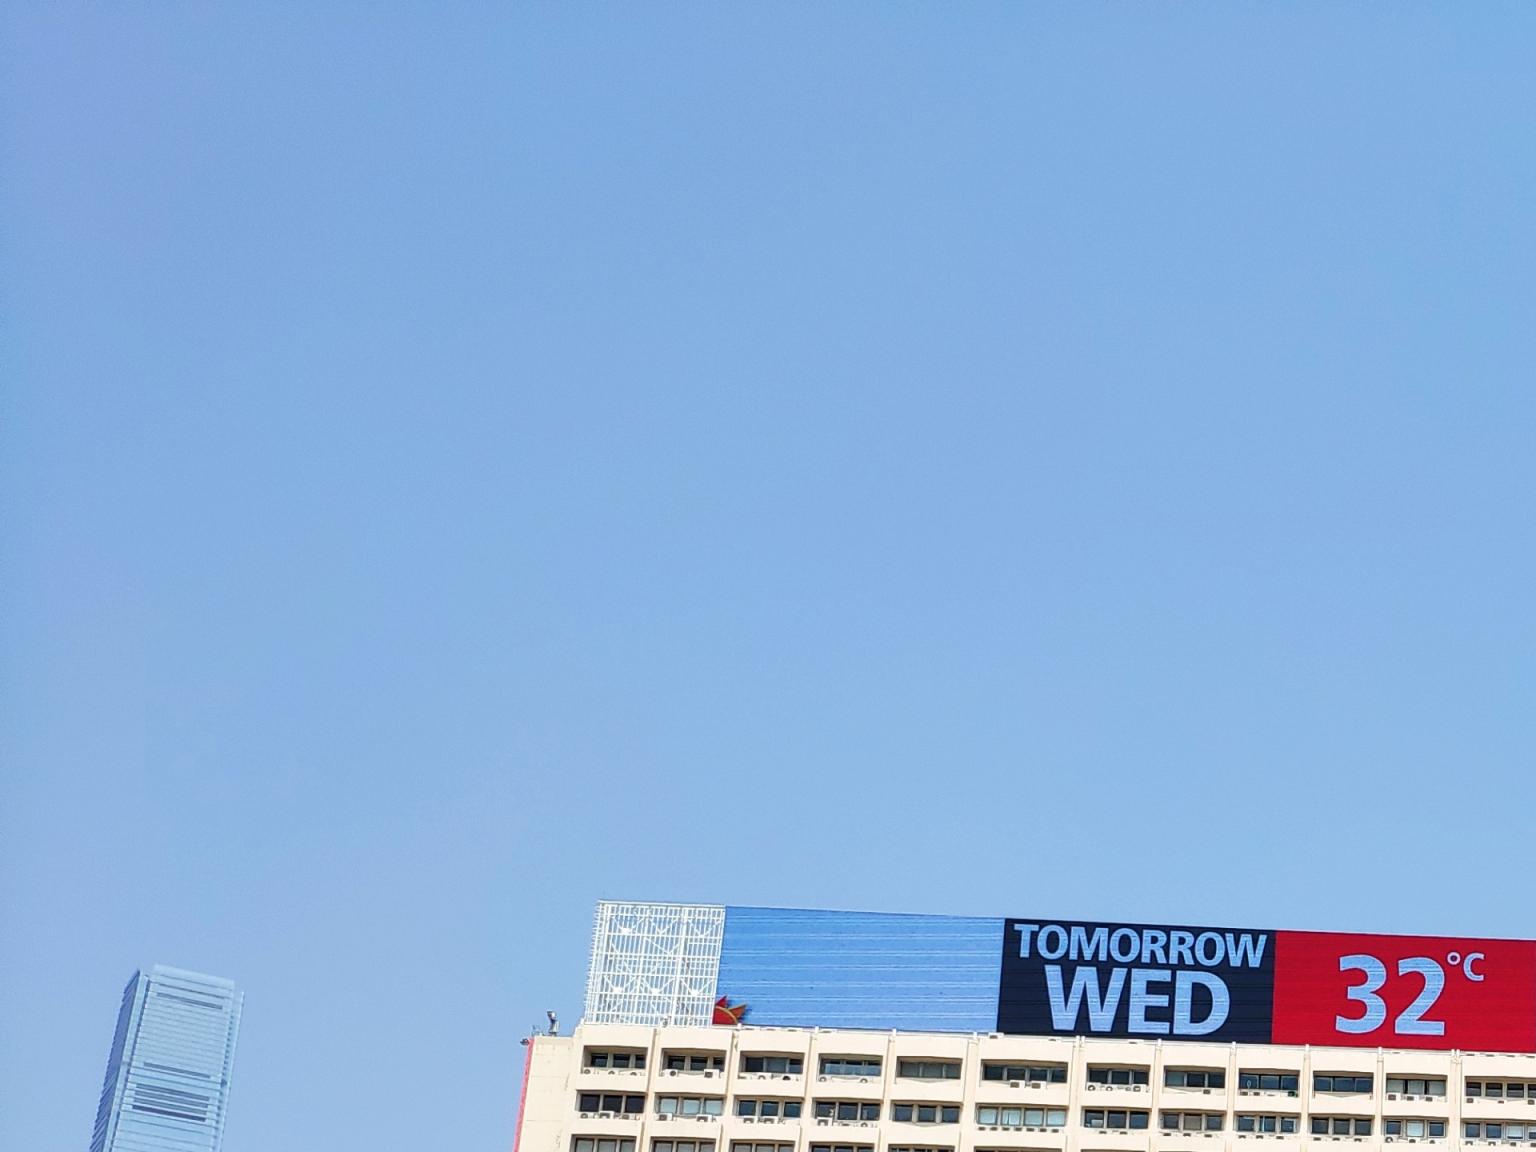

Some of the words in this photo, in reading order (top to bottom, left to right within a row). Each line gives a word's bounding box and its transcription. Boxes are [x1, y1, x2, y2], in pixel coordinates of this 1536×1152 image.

[1013, 923, 1268, 969] TOMORROW
[1044, 966, 1231, 1036] WED
[1335, 953, 1446, 1037] 32
[1446, 950, 1486, 983] °C
